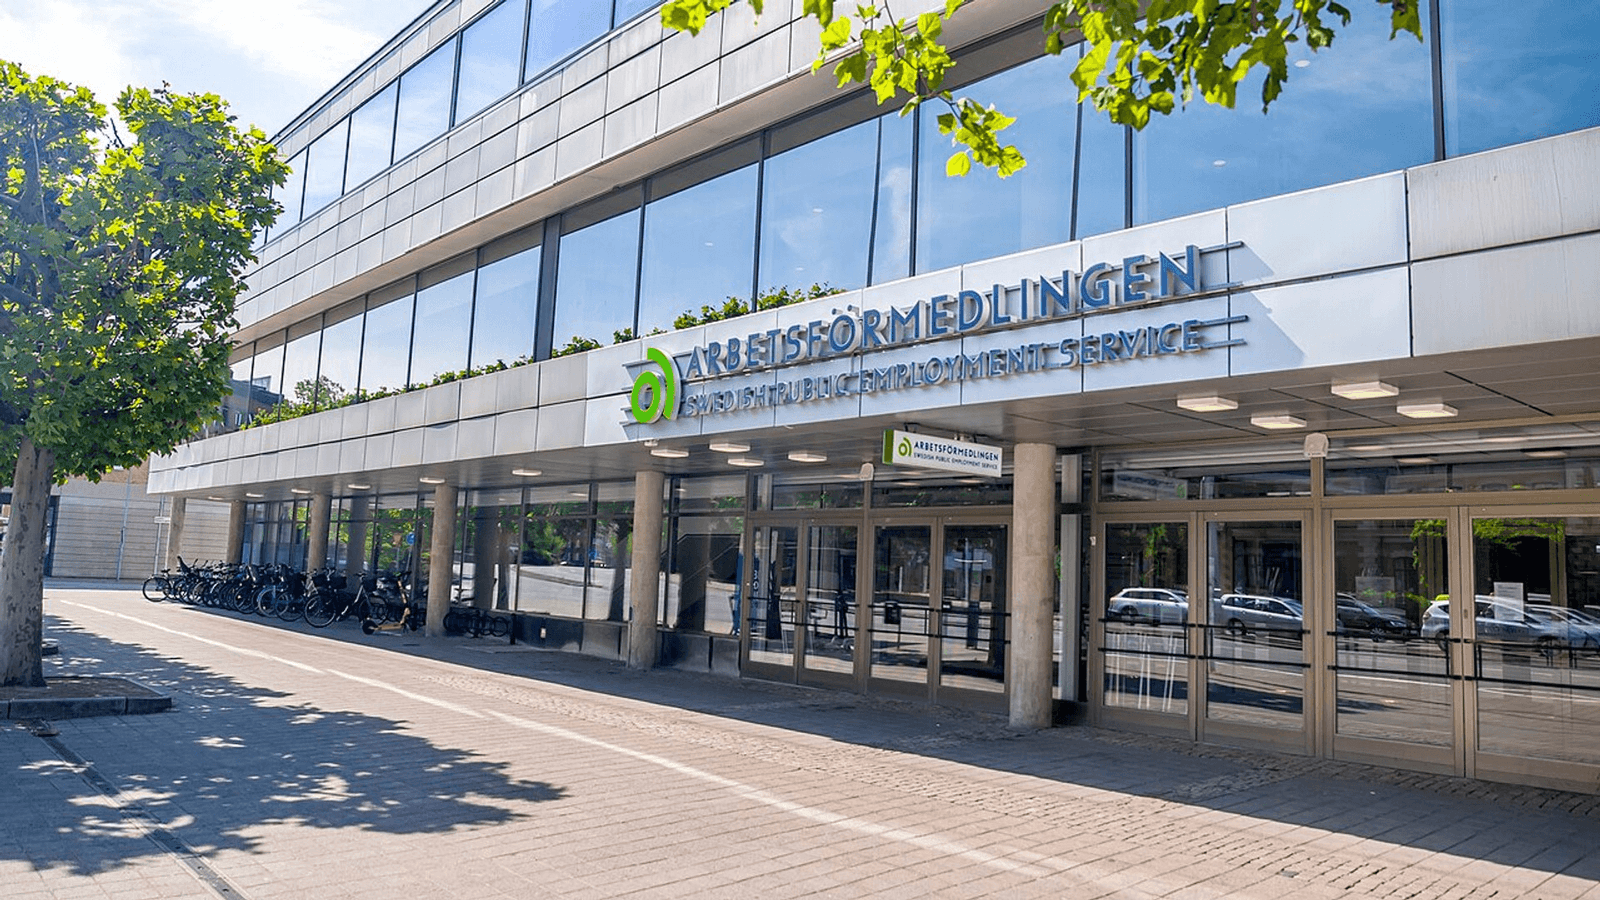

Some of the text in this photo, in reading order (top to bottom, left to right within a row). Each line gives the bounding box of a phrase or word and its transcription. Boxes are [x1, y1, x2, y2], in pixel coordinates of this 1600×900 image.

[686, 244, 1200, 378] ARBETSFÖRMEDLINGEN
[686, 319, 1201, 417] SWEDISH PUBLIC EMPLOYMENT SERVICE
[914, 441, 999, 461] ARBETSFÖRMEDLINGEN
